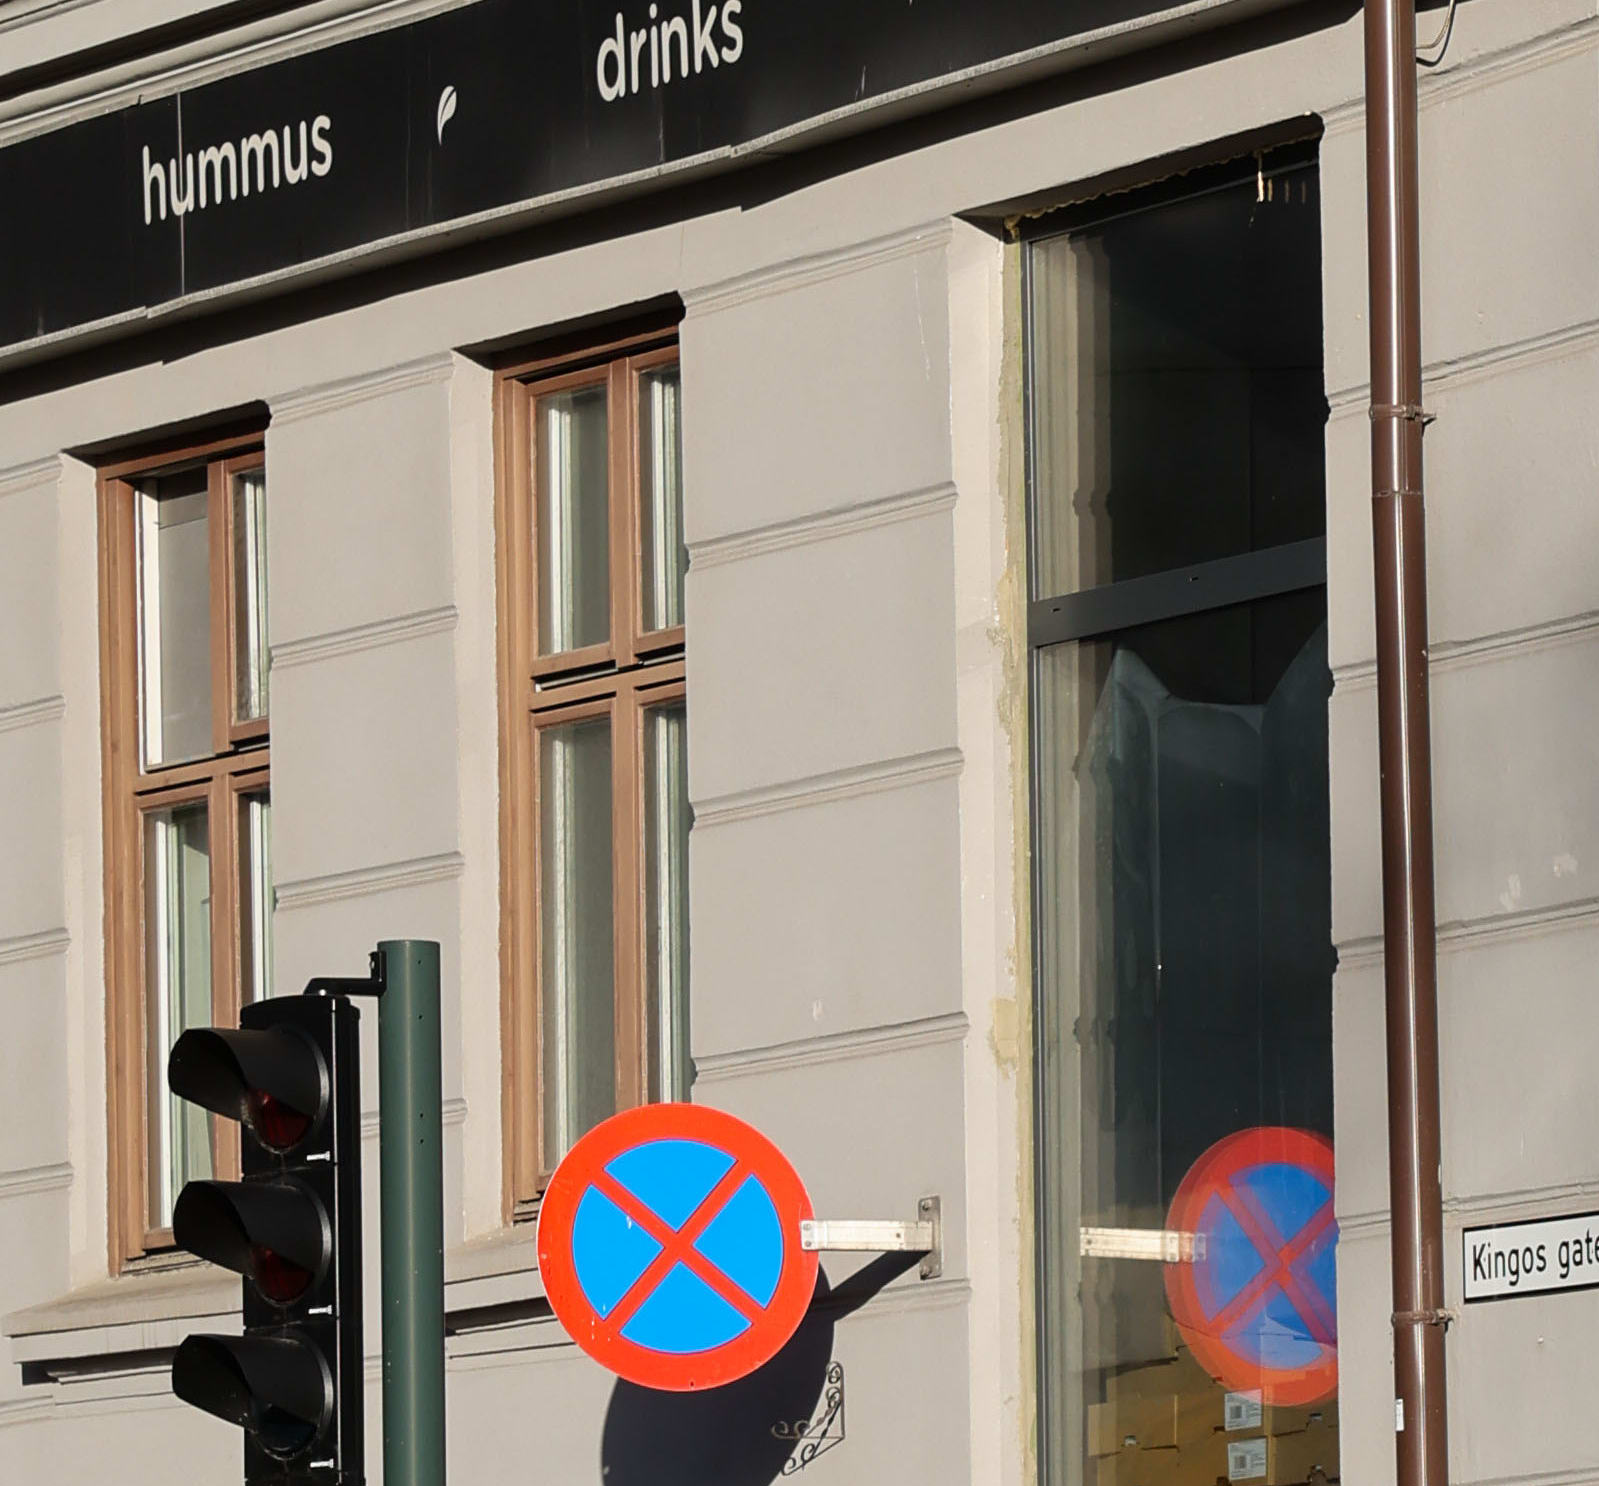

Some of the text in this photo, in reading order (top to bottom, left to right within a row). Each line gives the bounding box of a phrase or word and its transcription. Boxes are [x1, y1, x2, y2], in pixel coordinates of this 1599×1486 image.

[597, 0, 743, 101] drinks
[143, 115, 332, 225] hummus
[1473, 1241, 1547, 1286] Kingos
